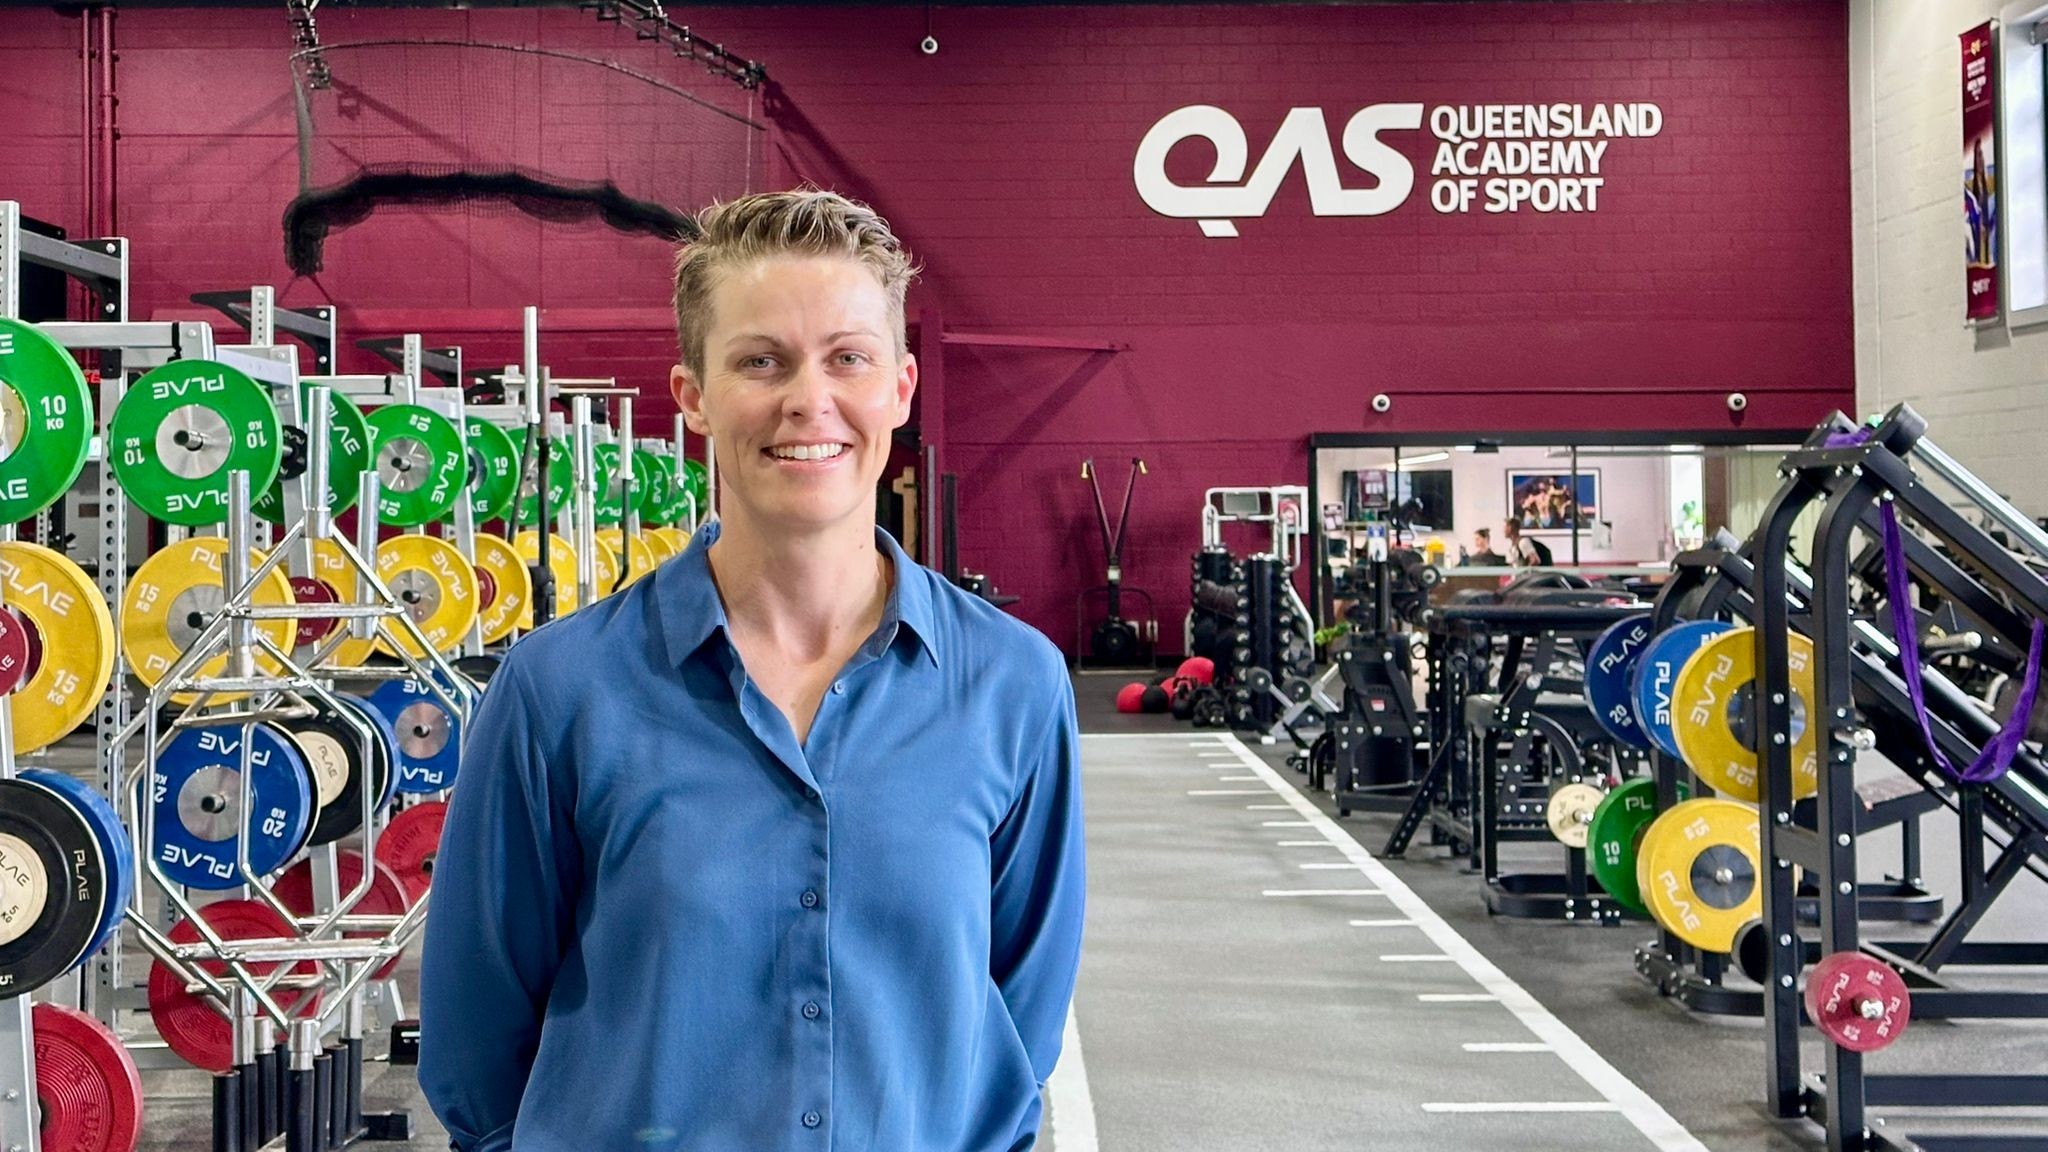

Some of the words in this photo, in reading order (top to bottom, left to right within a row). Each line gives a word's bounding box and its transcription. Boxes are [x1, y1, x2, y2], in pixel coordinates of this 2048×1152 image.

[1430, 103, 1663, 141] QUEENSLAND
[1430, 141, 1608, 176] ACADEMY
[1133, 102, 1424, 238] QAS
[1430, 178, 1477, 214] OF
[1484, 177, 1605, 214] SPORT
[152, 374, 225, 400] PLAE
[40, 394, 67, 417] 10
[46, 417, 65, 431] KG
[247, 420, 262, 430] KG
[125, 437, 140, 448] KG
[246, 432, 268, 449] 10
[124, 449, 145, 466] 10
[493, 456, 509, 469] 10
[430, 451, 459, 505] PLAE
[596, 507, 622, 517] PLA
[190, 546, 222, 573] PL
[317, 553, 345, 569] PL
[431, 550, 468, 601] PLAE
[0, 560, 75, 617] PLAE
[139, 582, 160, 602] 15
[293, 586, 316, 595] LAE
[481, 593, 520, 636] PLAE
[1599, 625, 1648, 674] PLAE
[1788, 651, 1808, 673] 15
[53, 669, 80, 695] 15
[402, 679, 456, 699] PAE
[1689, 654, 1734, 727] PLAE
[46, 689, 66, 706] KG
[1655, 661, 1671, 726] PLAE
[1608, 704, 1628, 724] 20
[198, 731, 271, 767] PAE
[318, 745, 338, 778] PLAE
[402, 766, 443, 784] PLA
[154, 786, 167, 803] 2
[1625, 796, 1653, 812] PL
[270, 807, 287, 820] KG
[262, 818, 286, 838] 20
[1691, 816, 1711, 838] 15
[1602, 841, 1620, 856] 10
[161, 843, 235, 879] PLAE
[73, 849, 90, 901] PLAE
[9, 905, 19, 915] 5
[1658, 869, 1701, 933] PLAE
[1825, 972, 1850, 1013] PLAE
[1876, 996, 1901, 1038] PLAE
